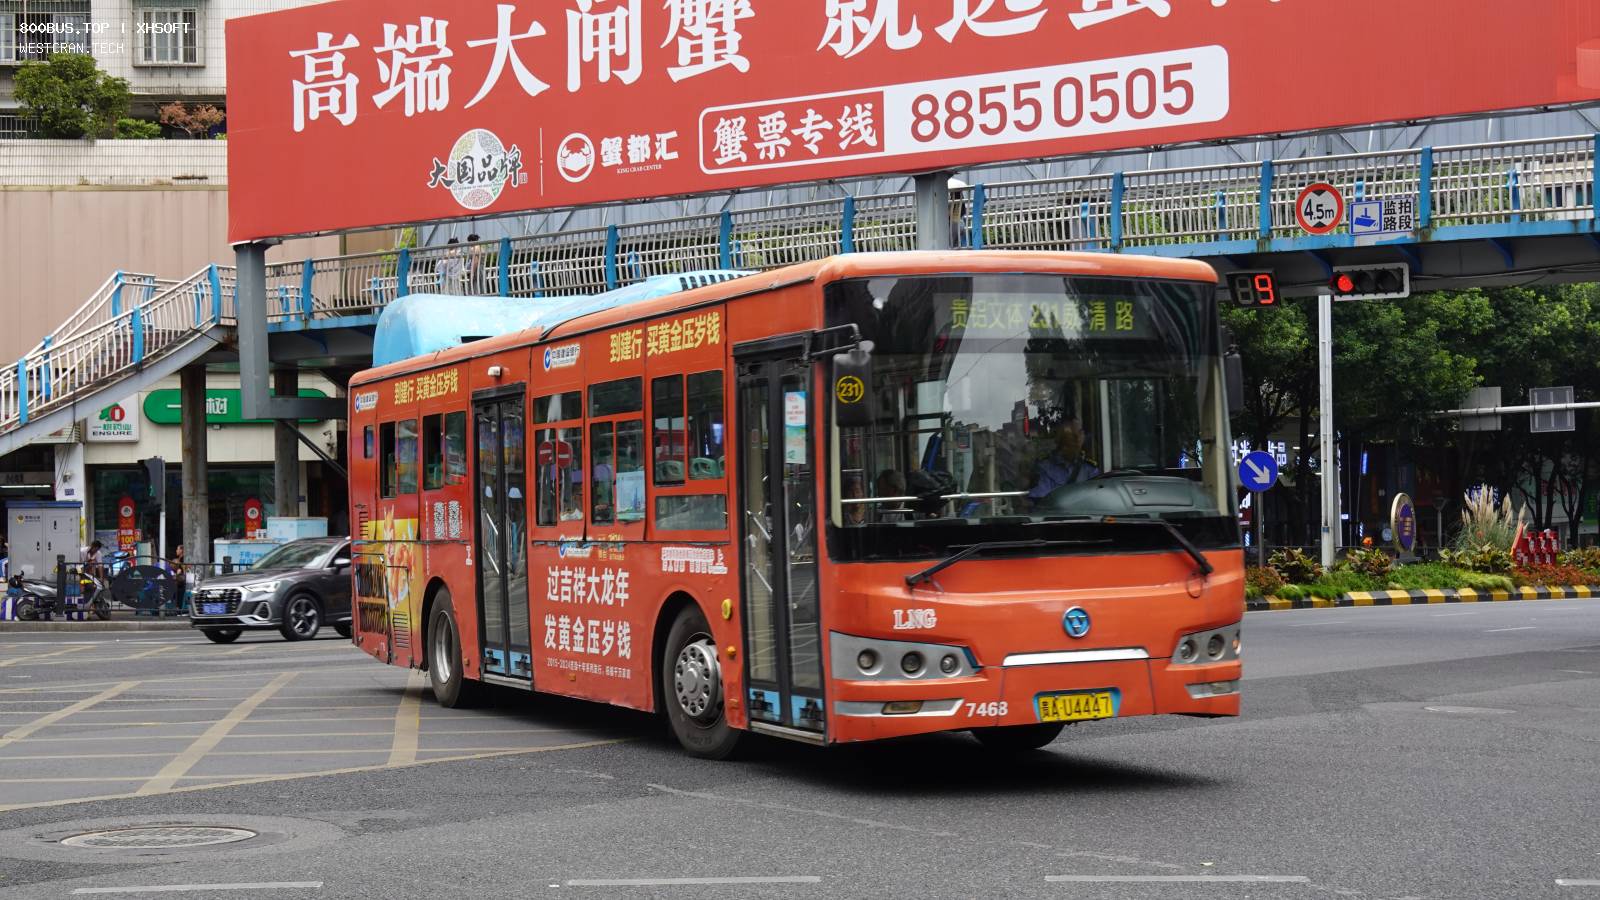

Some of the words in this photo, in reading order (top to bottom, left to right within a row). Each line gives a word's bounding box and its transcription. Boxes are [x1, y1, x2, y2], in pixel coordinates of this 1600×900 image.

[288, 0, 755, 132] 高端大闸蟹
[910, 62, 1194, 143] 88550505
[600, 131, 679, 167] 蟹都汇
[711, 102, 879, 166] 蟹票专线
[427, 144, 523, 188] 大国品牌
[1303, 198, 1335, 221] 4.5m
[1383, 199, 1412, 216] 监拍
[1383, 215, 1412, 231] 路段
[1254, 274, 1275, 304] 9
[609, 328, 643, 363] 到建行
[647, 311, 720, 357] 买黄金压岁钱
[394, 379, 414, 405] 到建行
[416, 368, 458, 401] 买黄金压岁钱
[840, 382, 859, 397] 231
[547, 565, 630, 607] 过吉祥大龙年
[544, 613, 631, 659] 发黄金压岁钱
[893, 608, 938, 630] LNG
[966, 702, 1008, 717] 7468
